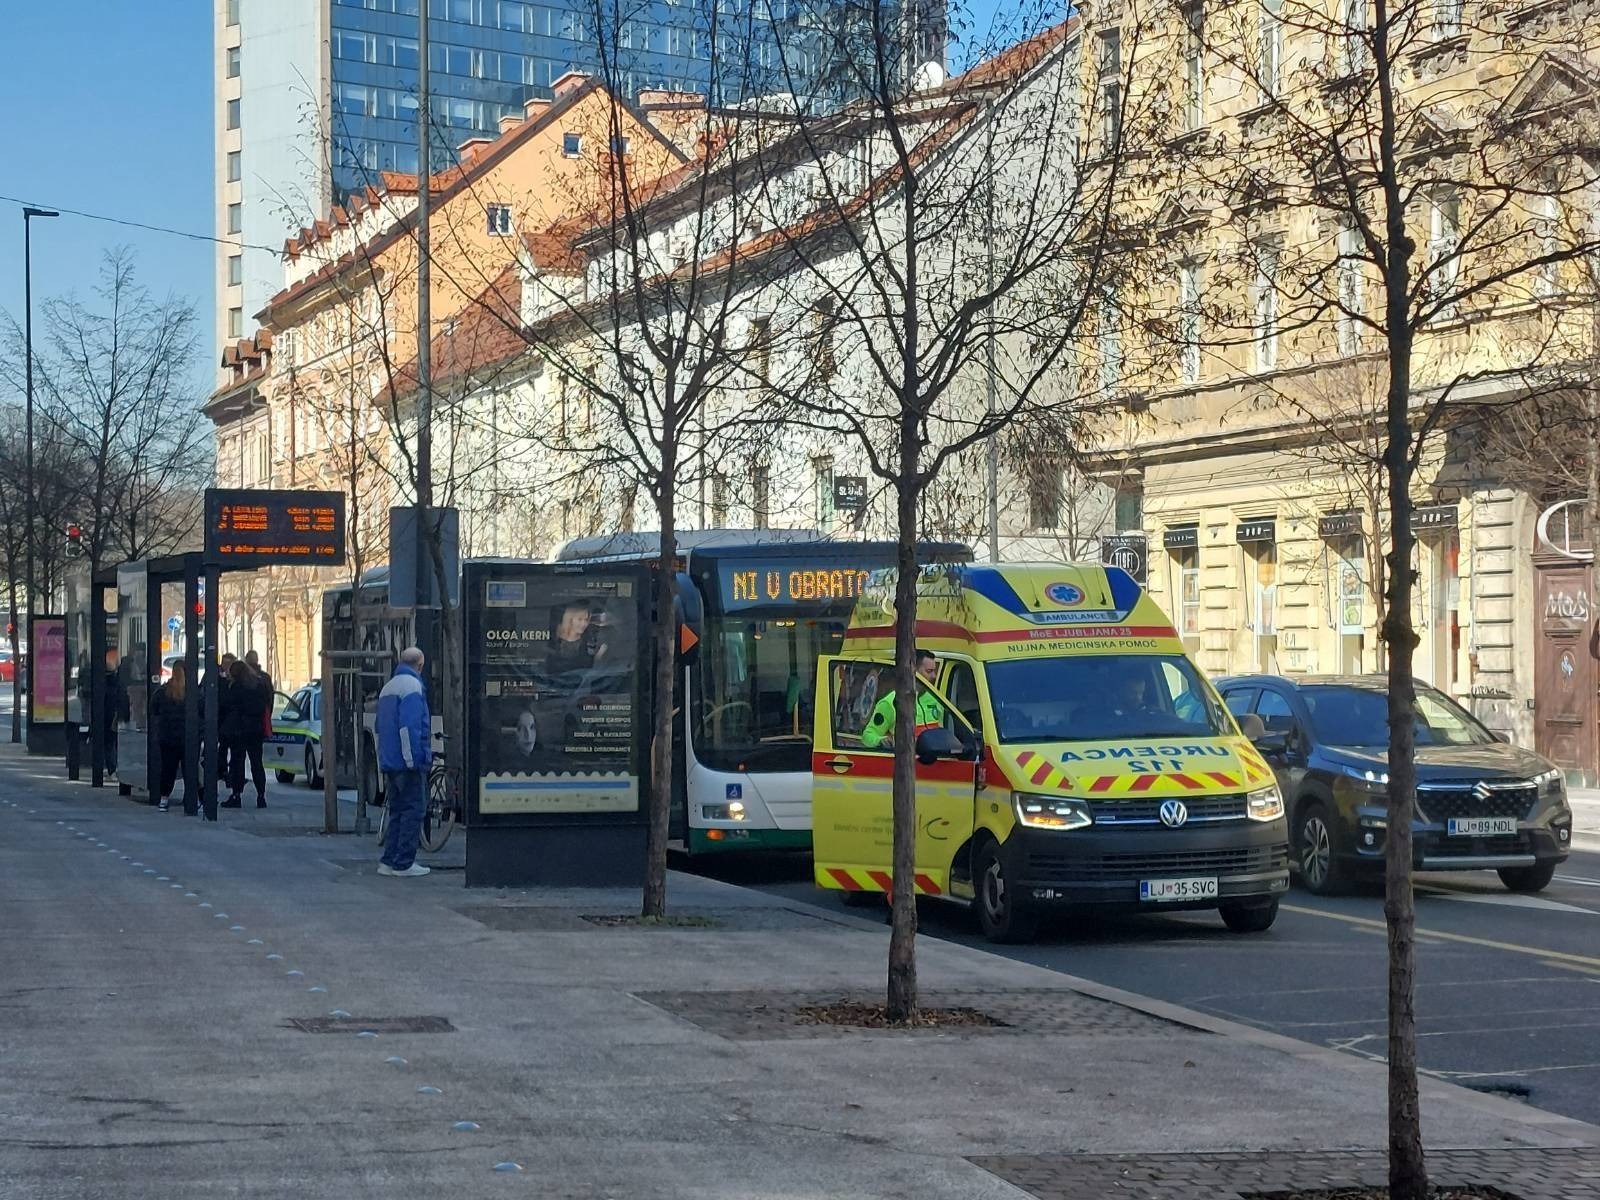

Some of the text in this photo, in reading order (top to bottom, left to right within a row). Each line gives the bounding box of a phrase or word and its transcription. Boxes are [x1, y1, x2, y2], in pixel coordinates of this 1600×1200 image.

[733, 571, 758, 600] NI
[767, 571, 780, 600] V
[1045, 613, 1106, 622] AMBULANCE
[486, 630, 550, 640] OLGA KERN
[1029, 628, 1132, 638] MoE LJUBLJANA 25
[1008, 642, 1045, 653] NUJNA
[1048, 640, 1116, 650] MEDICINSKA
